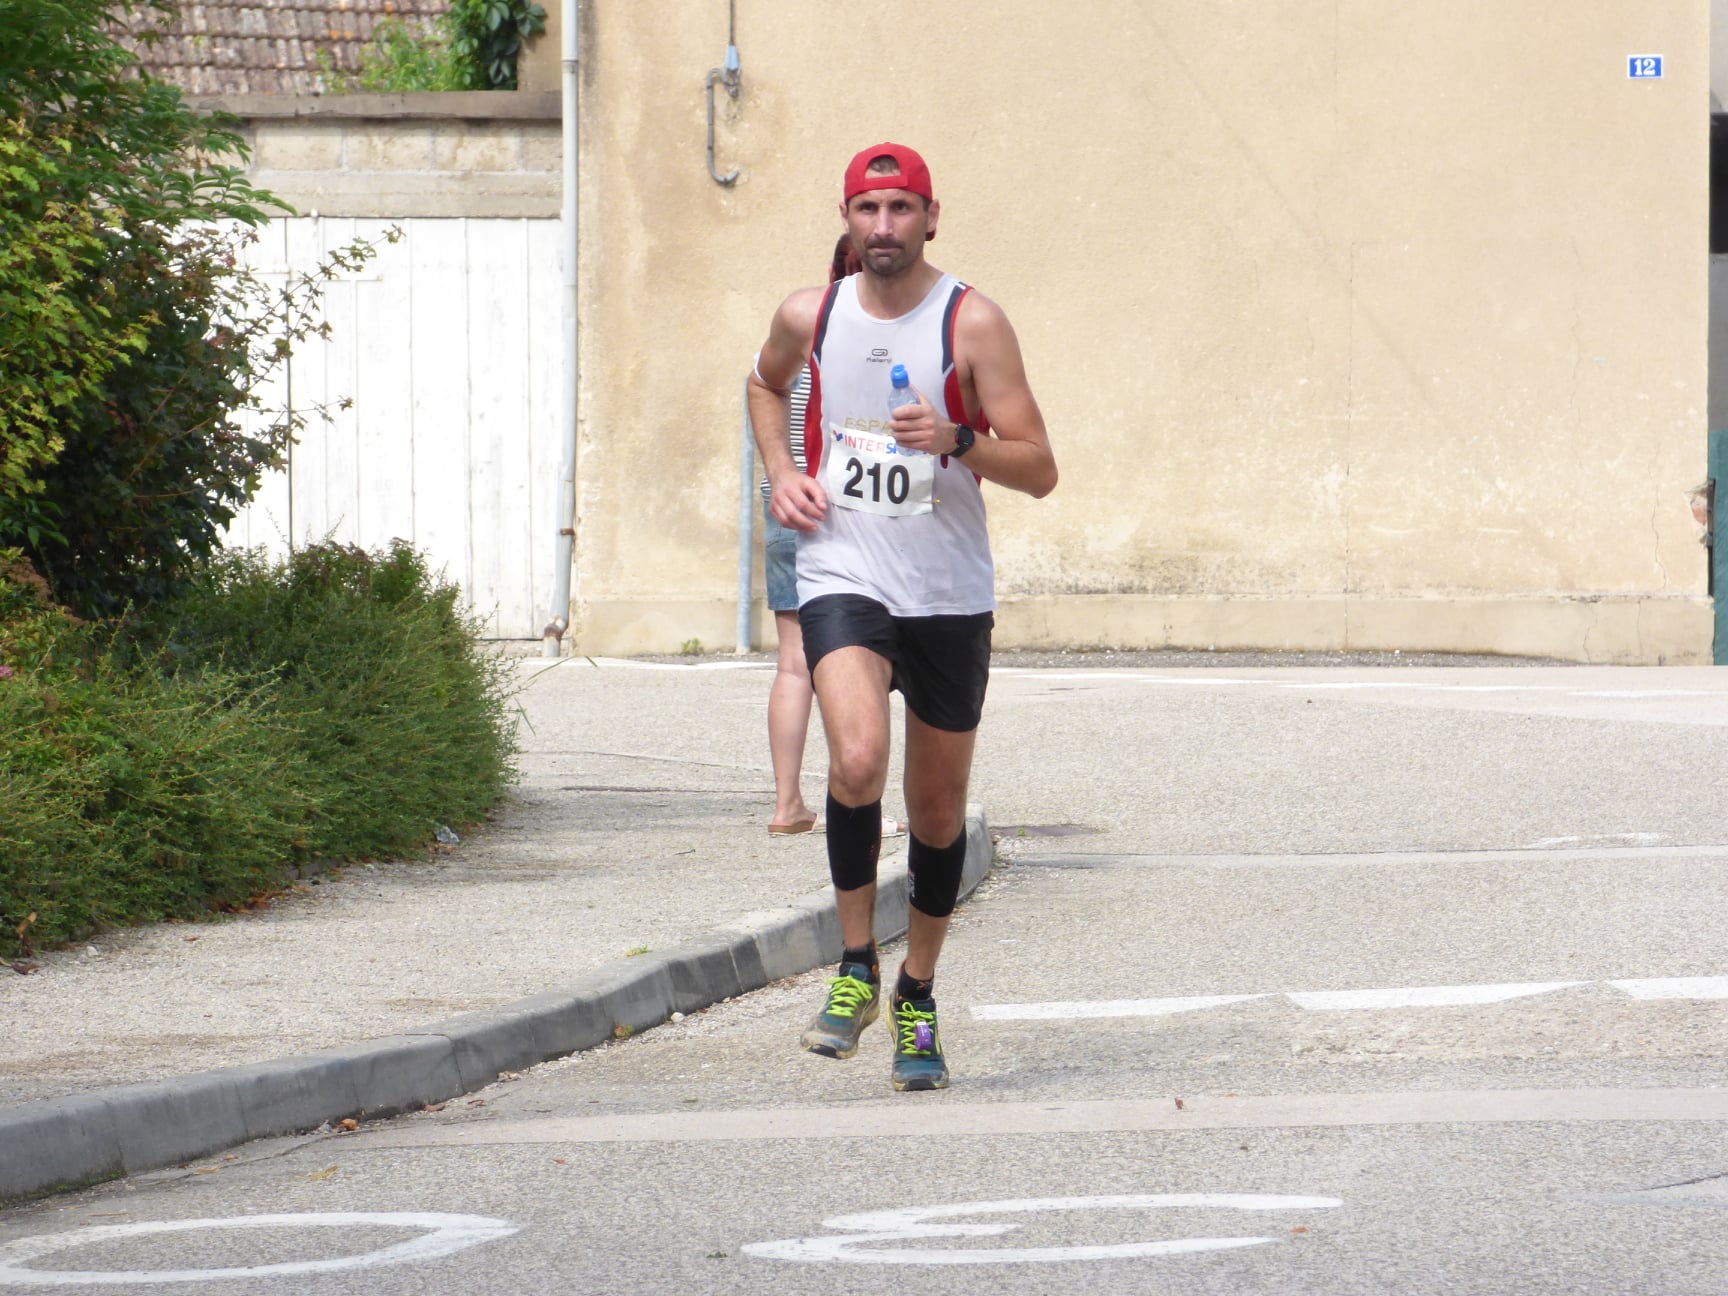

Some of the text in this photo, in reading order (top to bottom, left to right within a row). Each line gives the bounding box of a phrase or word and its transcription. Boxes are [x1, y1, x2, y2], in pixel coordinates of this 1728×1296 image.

[1634, 58, 1656, 76] 12
[844, 434, 898, 455] INTERS
[843, 456, 910, 505] 210
